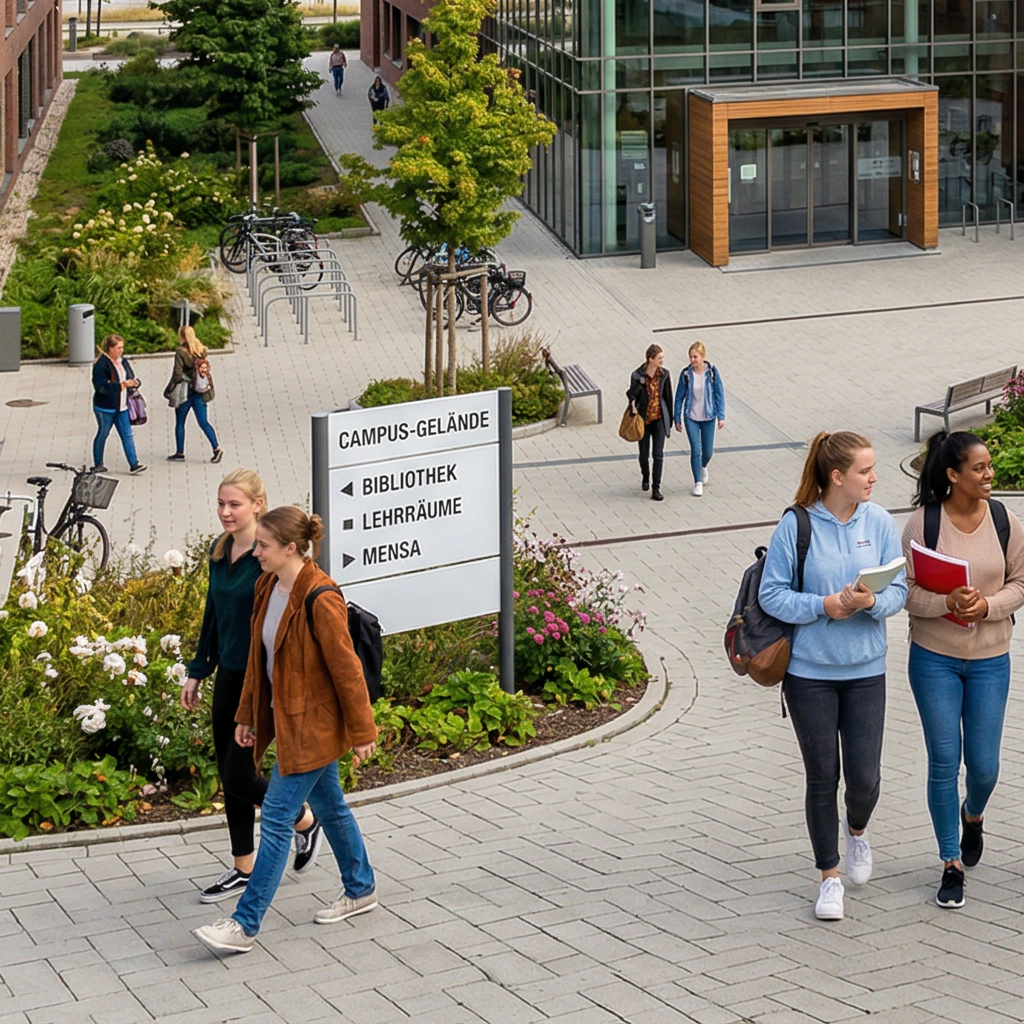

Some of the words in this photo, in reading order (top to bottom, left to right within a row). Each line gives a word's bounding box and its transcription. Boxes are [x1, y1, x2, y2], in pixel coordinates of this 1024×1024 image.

[339, 410, 490, 449] CAMPUS-GELÄNDE
[363, 463, 457, 495] BIBLIOTHEK
[363, 497, 462, 530] LEHRRÄUME
[363, 539, 421, 566] MENSA
